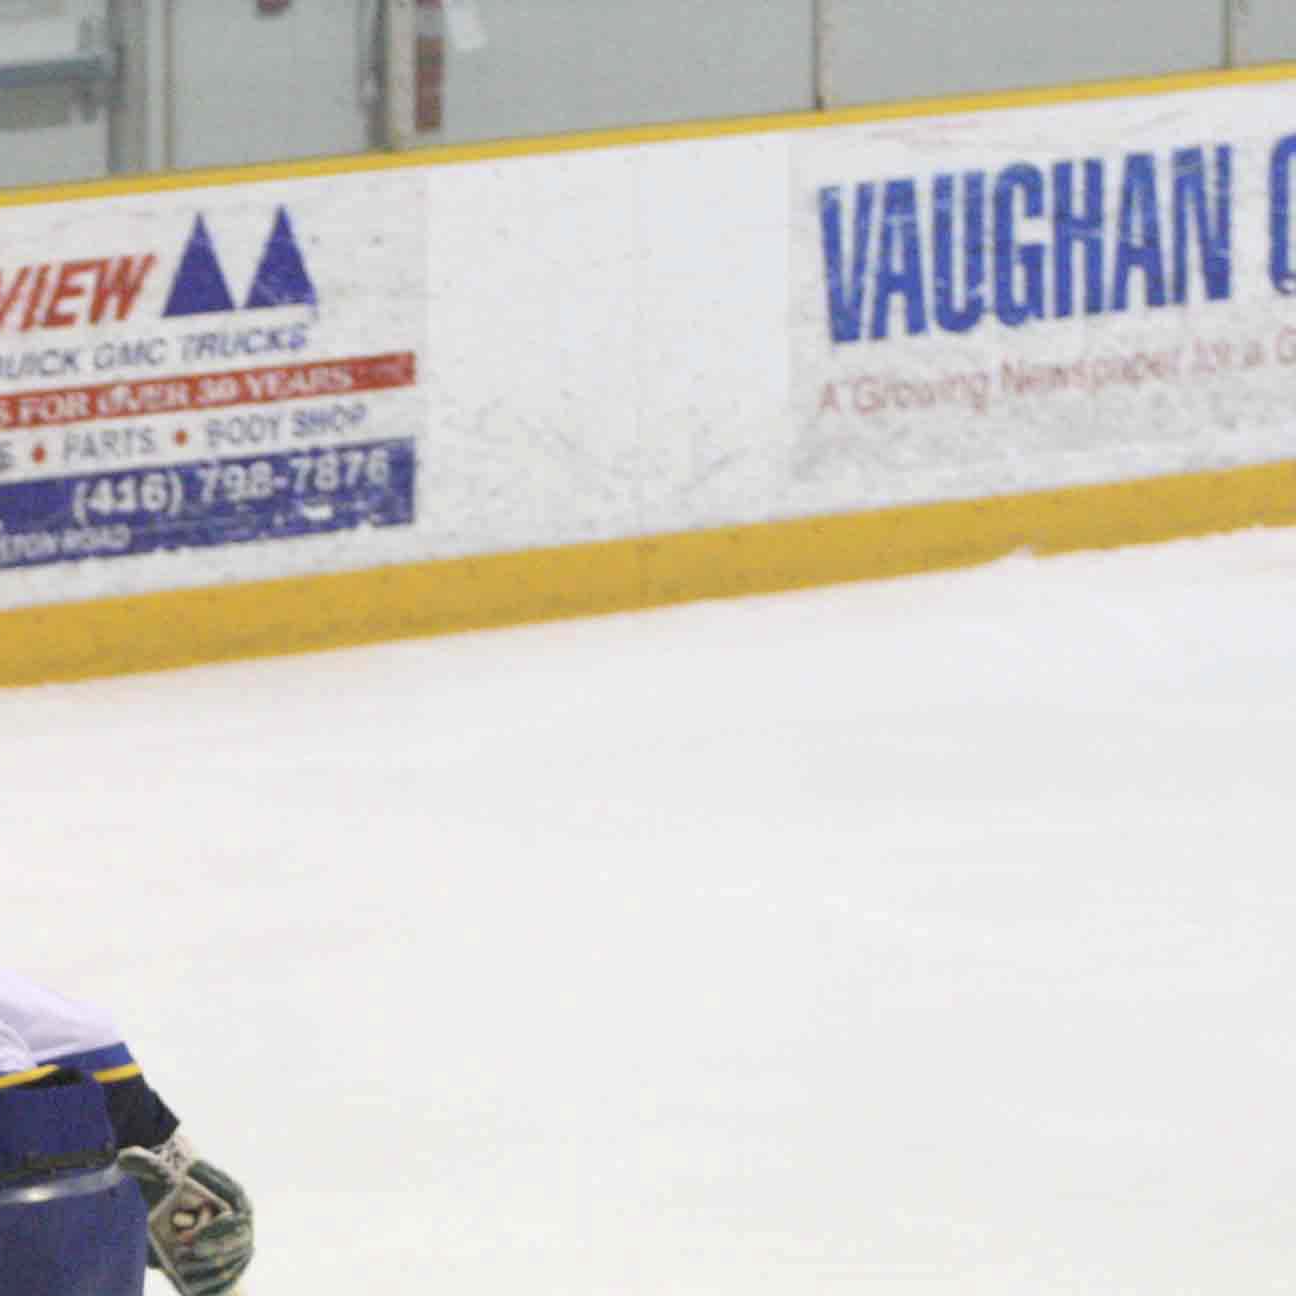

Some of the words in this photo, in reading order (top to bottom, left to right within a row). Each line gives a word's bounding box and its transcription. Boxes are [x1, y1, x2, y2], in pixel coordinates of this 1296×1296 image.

[818, 144, 1232, 344] VAUGHAN
[93, 337, 167, 371] GMC
[180, 322, 309, 362] TRUCKS
[20, 393, 89, 424] FOR
[244, 365, 353, 401] YEARS
[63, 427, 157, 462] PARTS
[206, 411, 281, 448] BODY
[290, 402, 369, 439] SHOP
[71, 472, 183, 525] (416)
[198, 446, 390, 503] 798-7876
